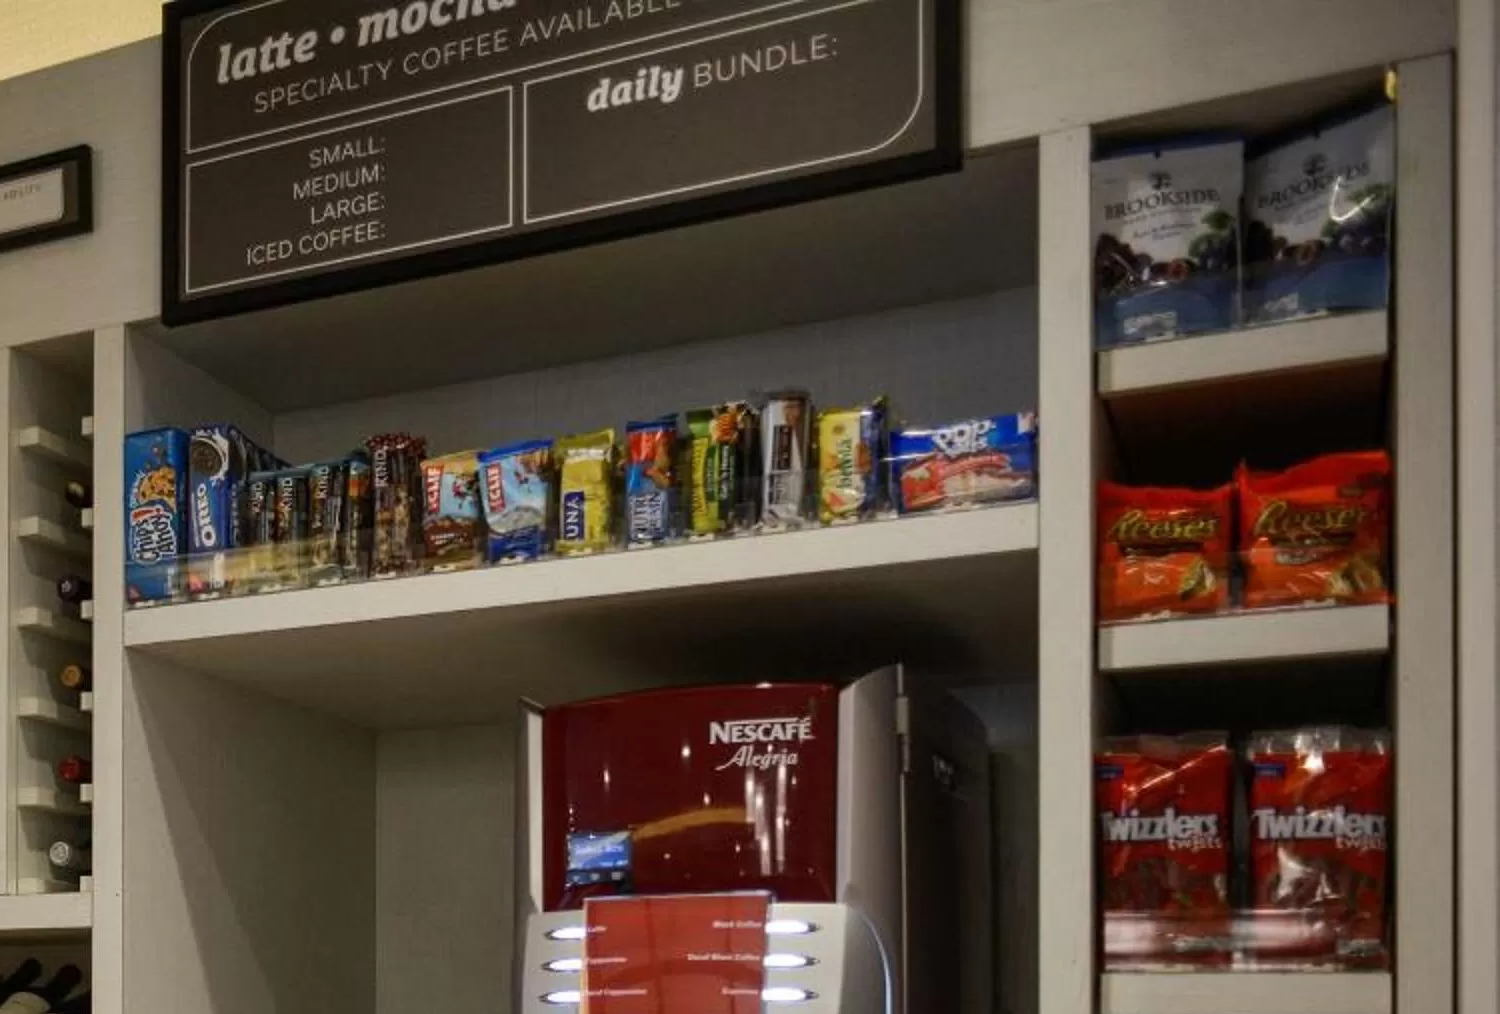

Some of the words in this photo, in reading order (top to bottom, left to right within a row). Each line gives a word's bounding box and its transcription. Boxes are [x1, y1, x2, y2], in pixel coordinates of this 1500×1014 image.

[216, 29, 319, 84] latte
[254, 58, 394, 113] SPECIALTY
[403, 27, 509, 76] COFFEE
[586, 64, 685, 112] daily
[693, 33, 838, 88] BUNDLE:
[308, 135, 386, 169] SMALL:
[292, 163, 386, 201] MEDIUM:
[310, 191, 386, 225] LARGE:
[1104, 187, 1221, 220] BROOKSIDE
[245, 238, 294, 267] ICED
[298, 220, 386, 254] COFFEE:
[375, 449, 389, 487] KIND
[196, 483, 217, 547] OREO
[564, 494, 582, 539] UNA
[133, 519, 160, 562] Chips
[708, 715, 816, 744] NESCAFÉ
[1100, 806, 1220, 841] Twizzlers
